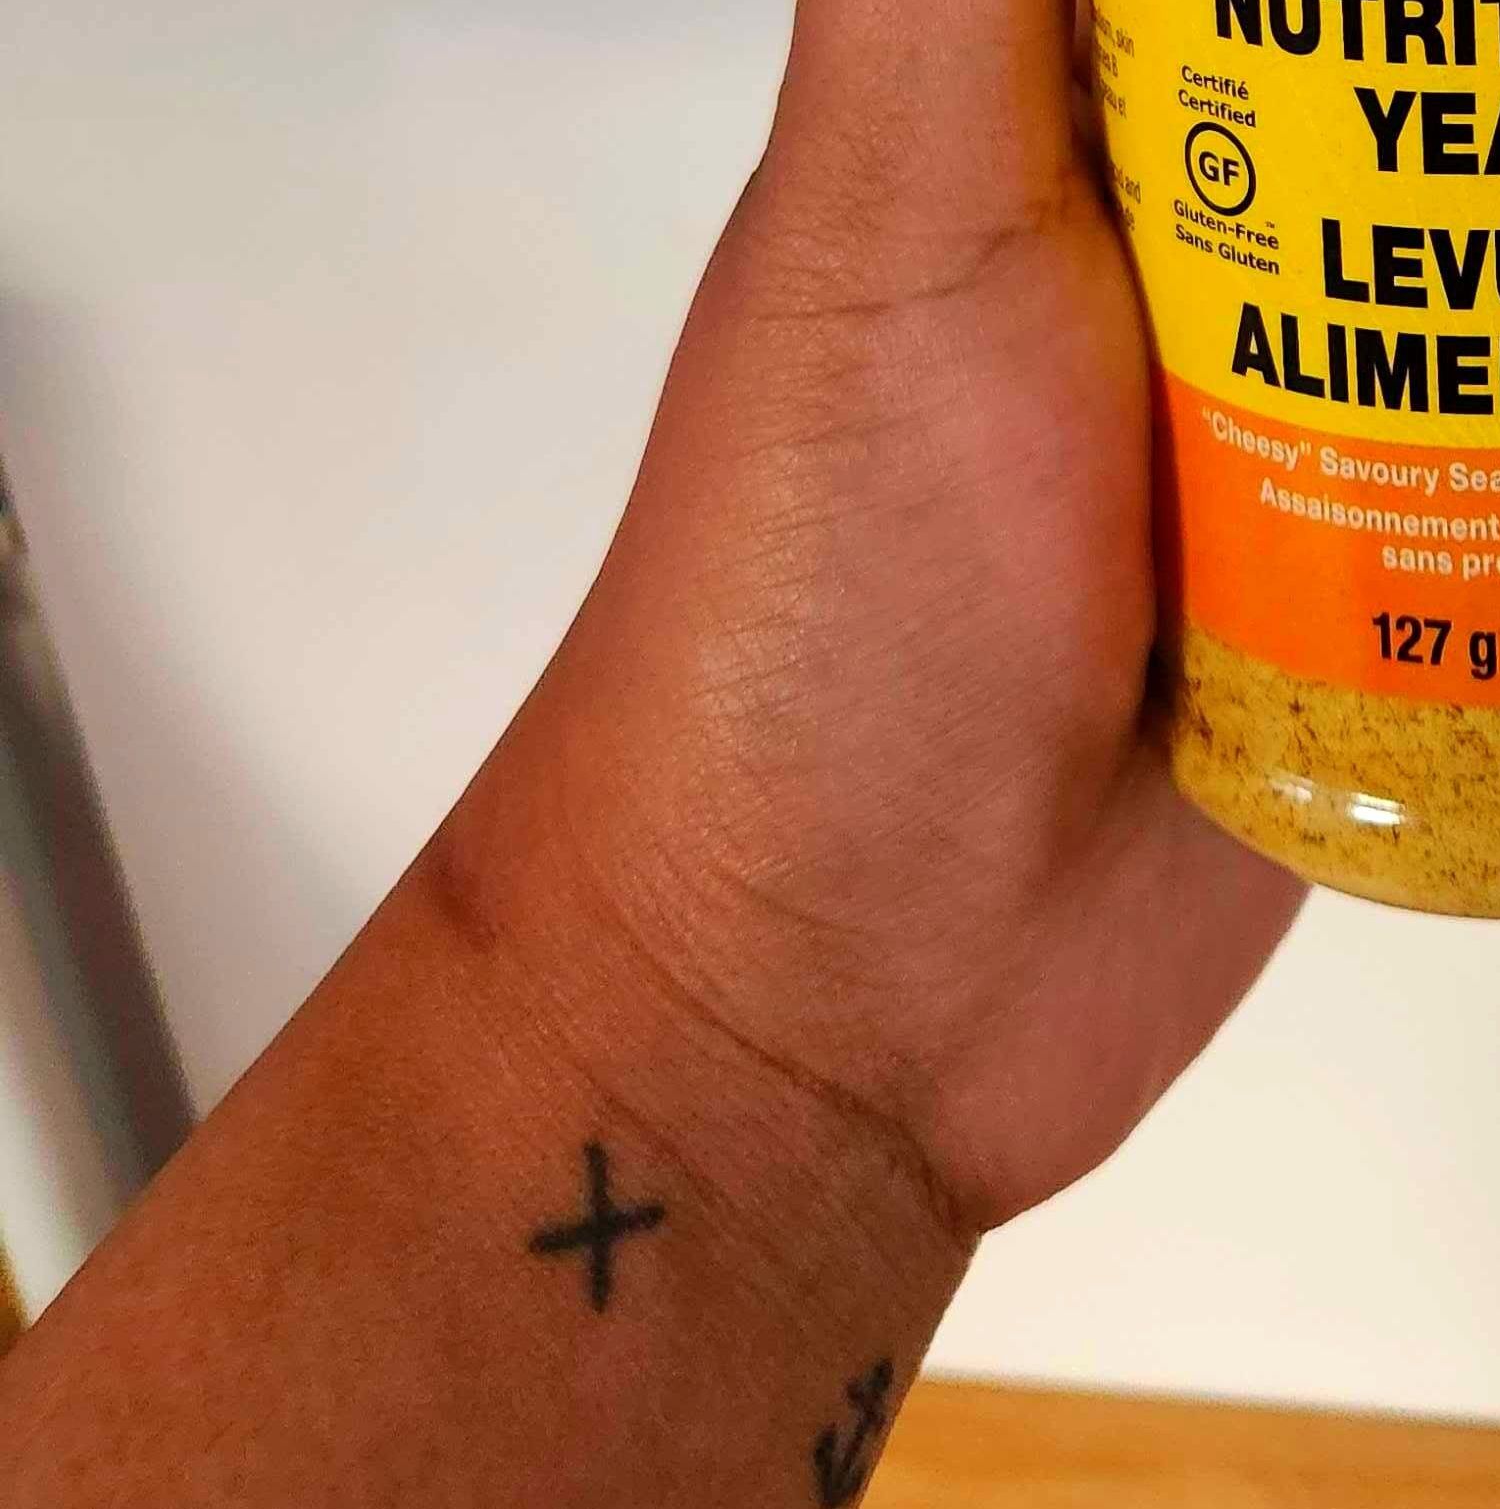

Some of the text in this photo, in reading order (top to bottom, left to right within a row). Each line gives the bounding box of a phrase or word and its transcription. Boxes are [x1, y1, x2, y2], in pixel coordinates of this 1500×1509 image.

[1180, 64, 1250, 101] Certifié
[1177, 88, 1257, 129] Certified
[1198, 150, 1240, 186] GF
[1173, 198, 1280, 250] Gluten-Free
[1175, 223, 1280, 276] Sans Gluten
[1319, 446, 1440, 497] Savoury
[1259, 477, 1500, 542] Assaisonnement
[1382, 544, 1454, 575] sans
[1371, 611, 1454, 666] 127
[1468, 627, 1499, 681] g
